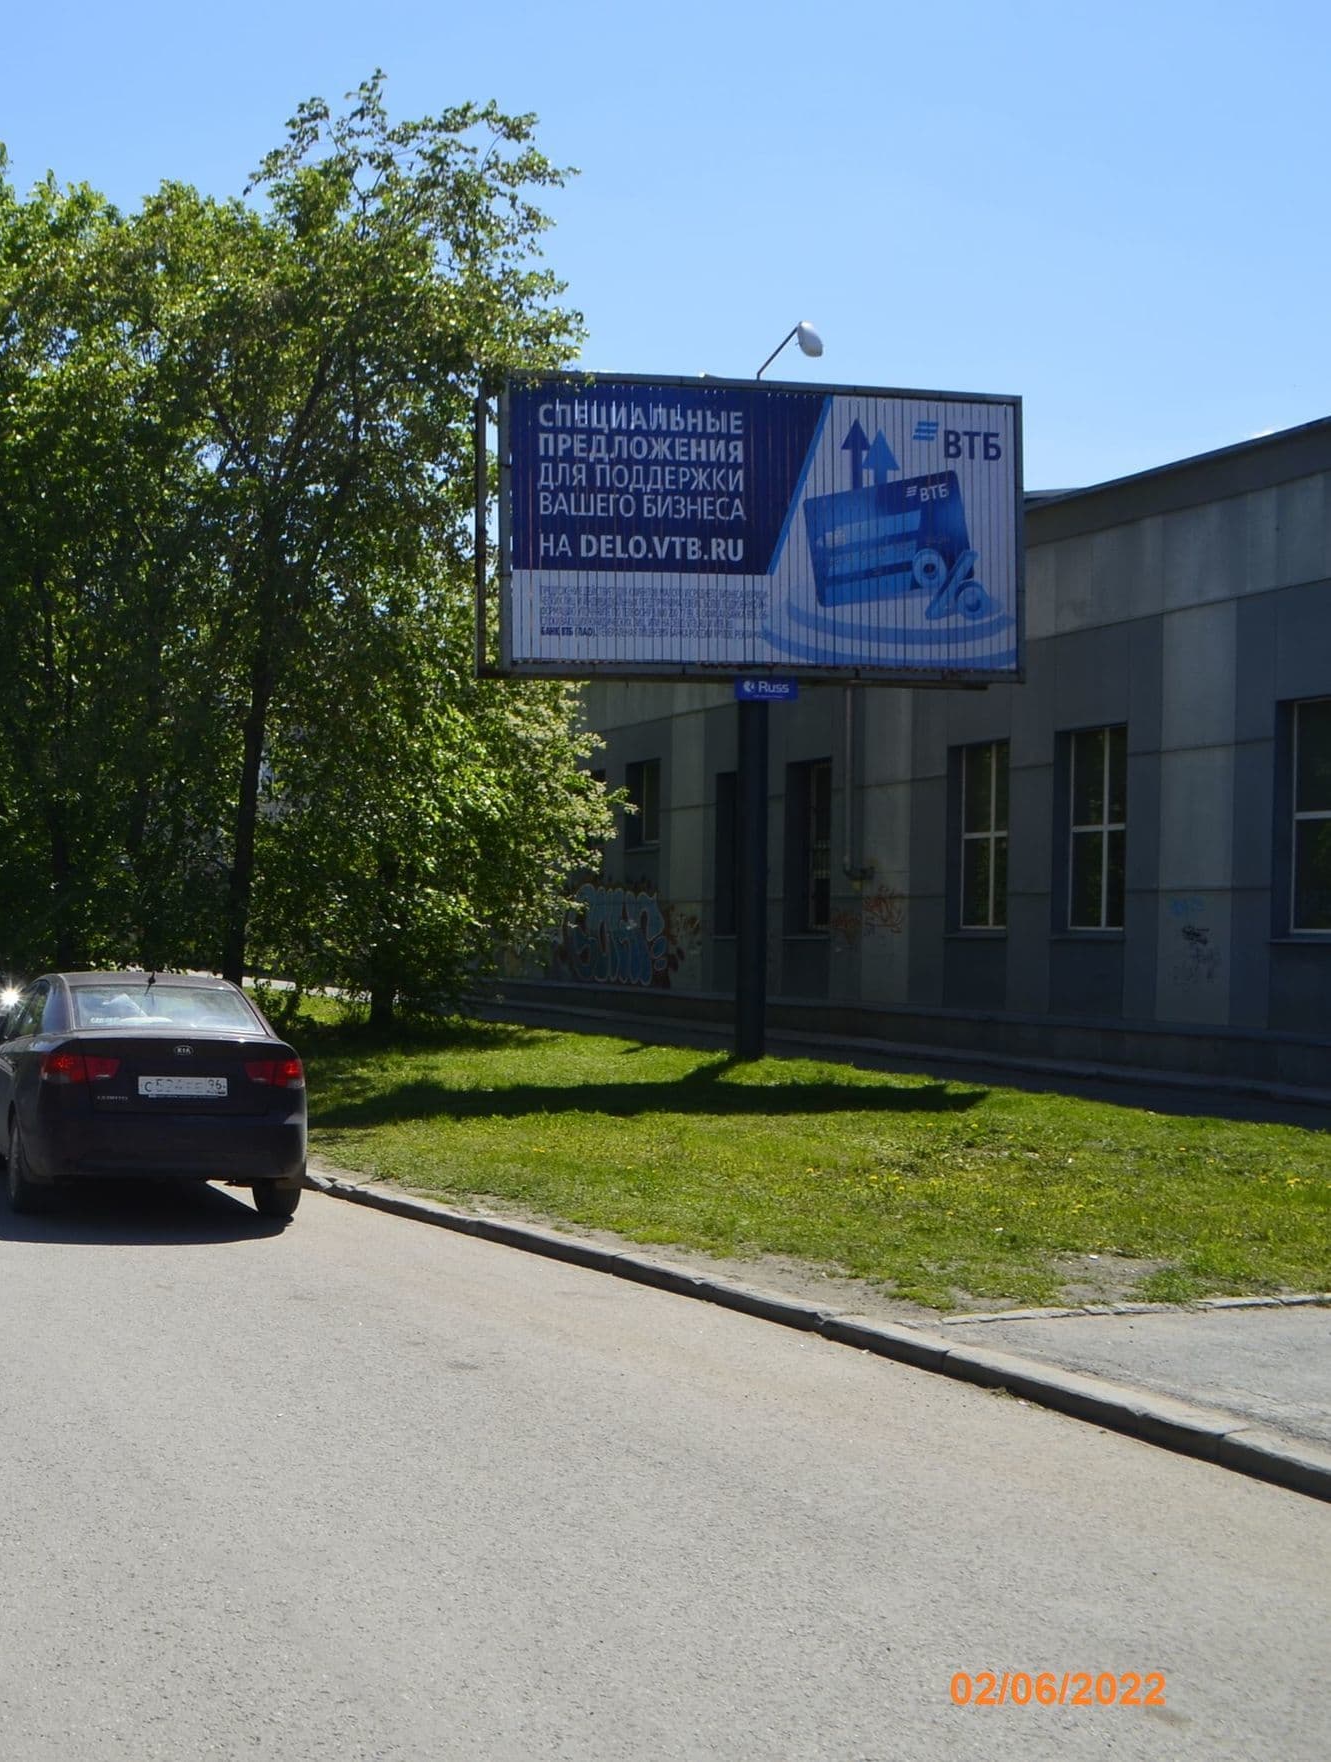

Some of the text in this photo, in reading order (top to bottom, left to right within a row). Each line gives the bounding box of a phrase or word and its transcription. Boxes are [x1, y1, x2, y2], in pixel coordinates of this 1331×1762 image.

[538, 403, 743, 435] СПЕЦИАЛЬНЫЕ
[538, 433, 744, 464] ПРЕДЛОЖЕНИЯ
[943, 429, 1002, 462] ВТБ
[537, 463, 744, 493] ДЛЯ ПОДДЕРЖКИ
[920, 483, 950, 503] ВТБ
[539, 491, 747, 521] ВАШЕГО БИЗНЕСА
[539, 533, 744, 562] НА DELO.VTB.RU
[758, 680, 790, 693] Russ
